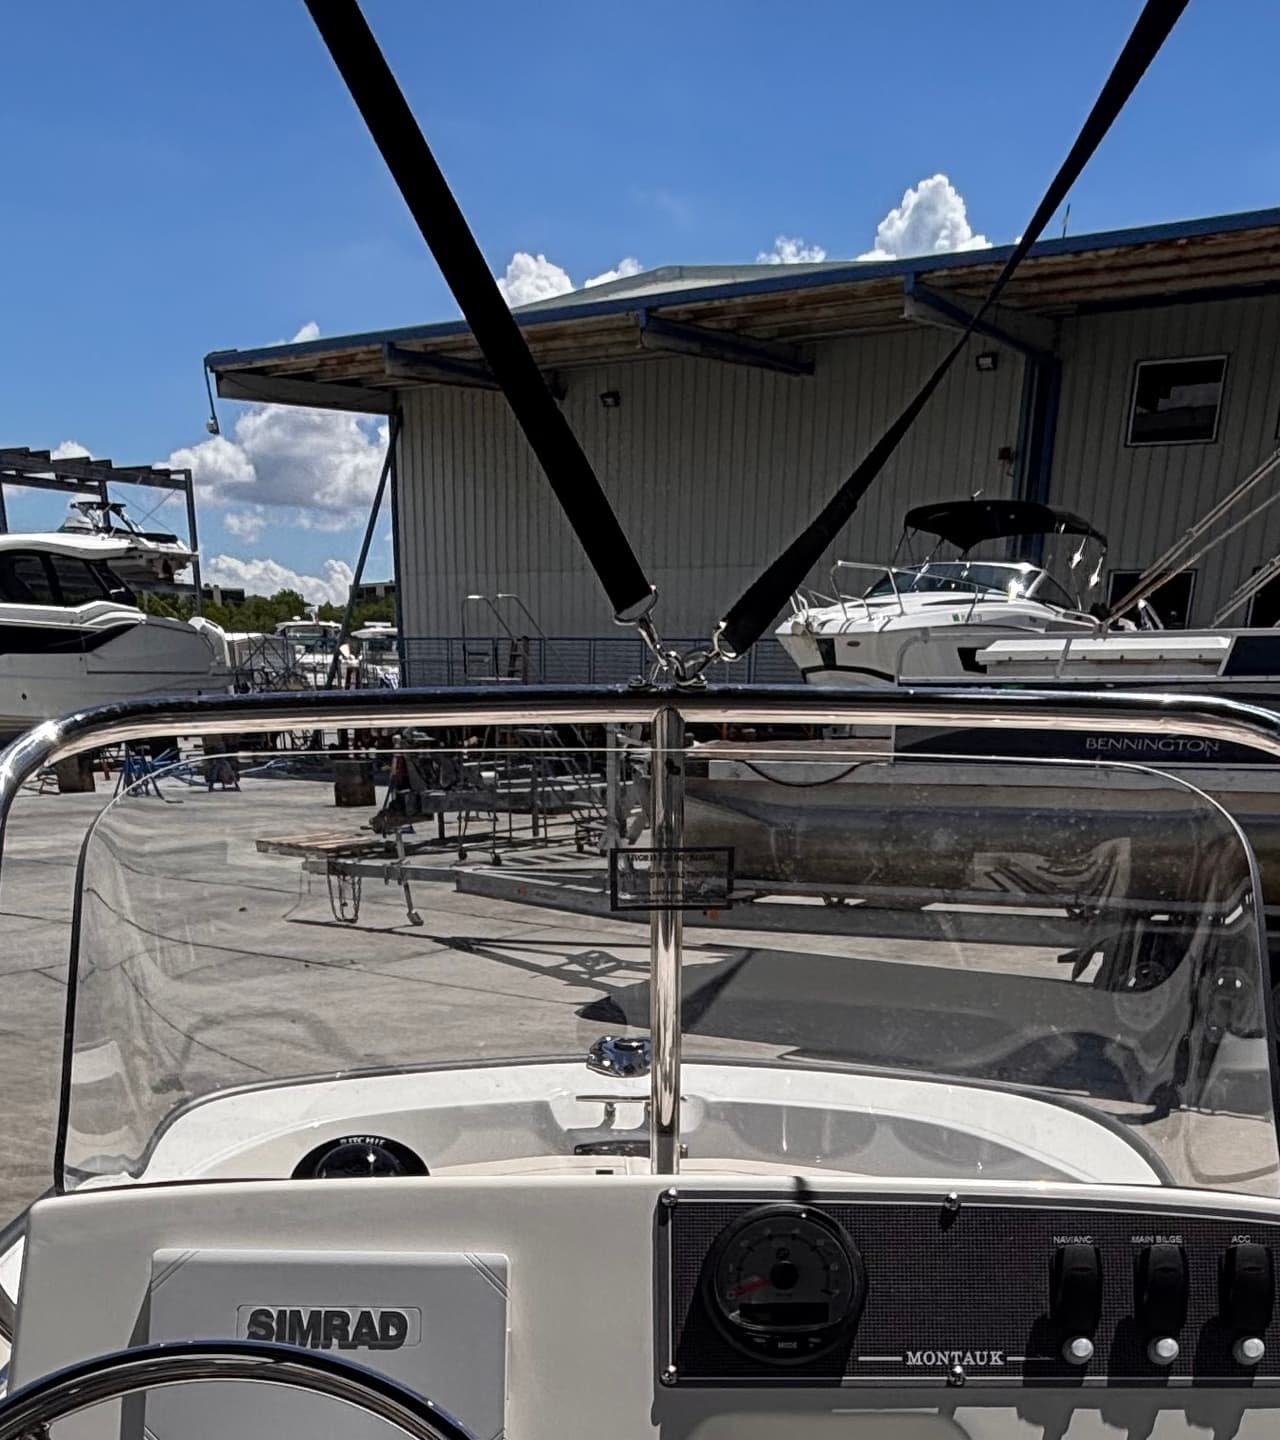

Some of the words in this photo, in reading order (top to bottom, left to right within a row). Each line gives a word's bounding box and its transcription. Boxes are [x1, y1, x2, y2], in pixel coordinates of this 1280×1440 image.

[1086, 738, 1219, 751] BENNINGTON
[1131, 1235, 1154, 1244] MAIN
[1155, 1235, 1183, 1244] BILGE
[1231, 1235, 1251, 1243] ACC
[247, 1308, 408, 1350] SIMRAD
[906, 1350, 1004, 1365] MONTAUK
